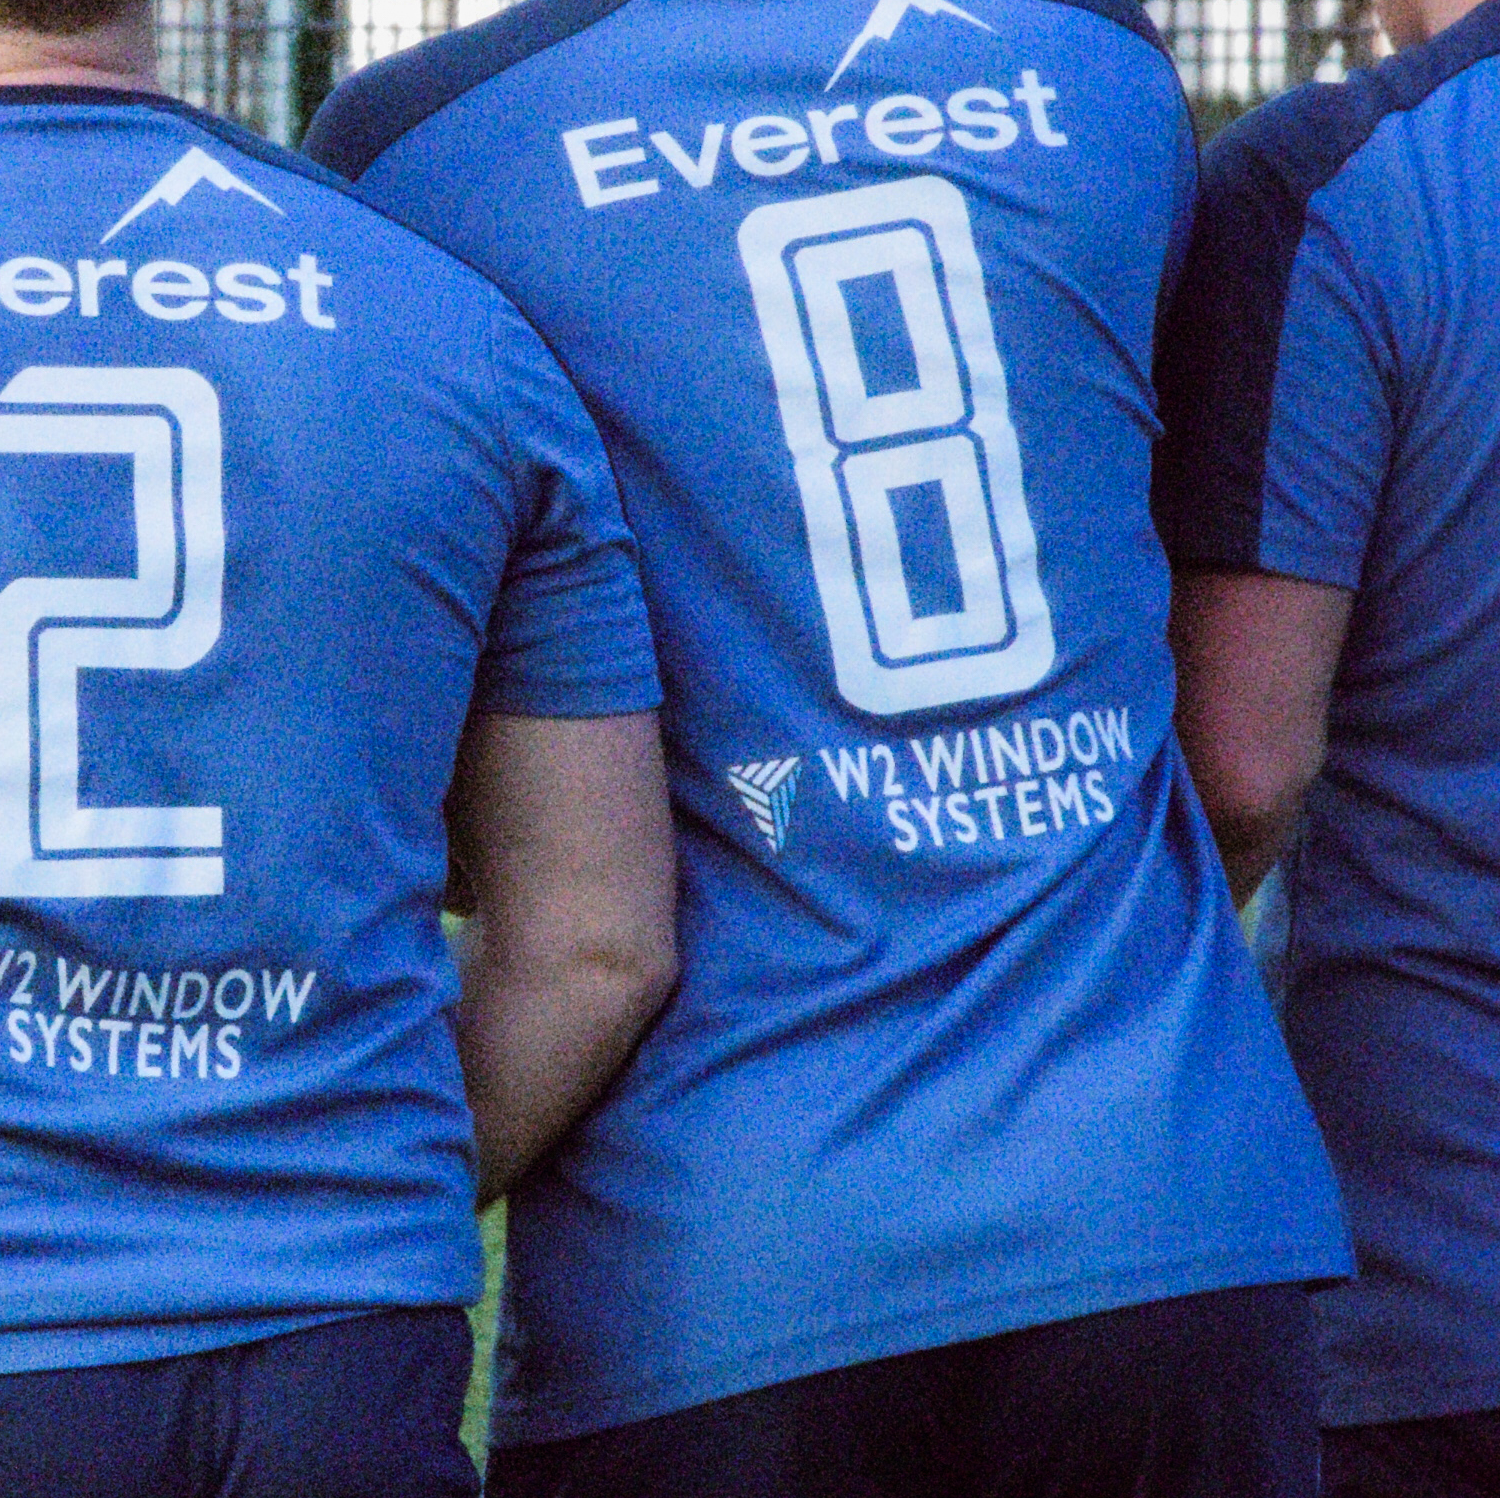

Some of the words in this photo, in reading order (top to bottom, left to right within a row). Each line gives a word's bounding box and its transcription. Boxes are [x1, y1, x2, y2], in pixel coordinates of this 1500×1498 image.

[562, 68, 1069, 210] Everest
[738, 175, 1056, 715] 8
[819, 744, 905, 801] W2
[911, 707, 1133, 792] WINDOW
[887, 770, 1115, 852] SYSTEMS
[56, 958, 317, 1023] WINDOW
[7, 1010, 241, 1079] SYSTEMS
